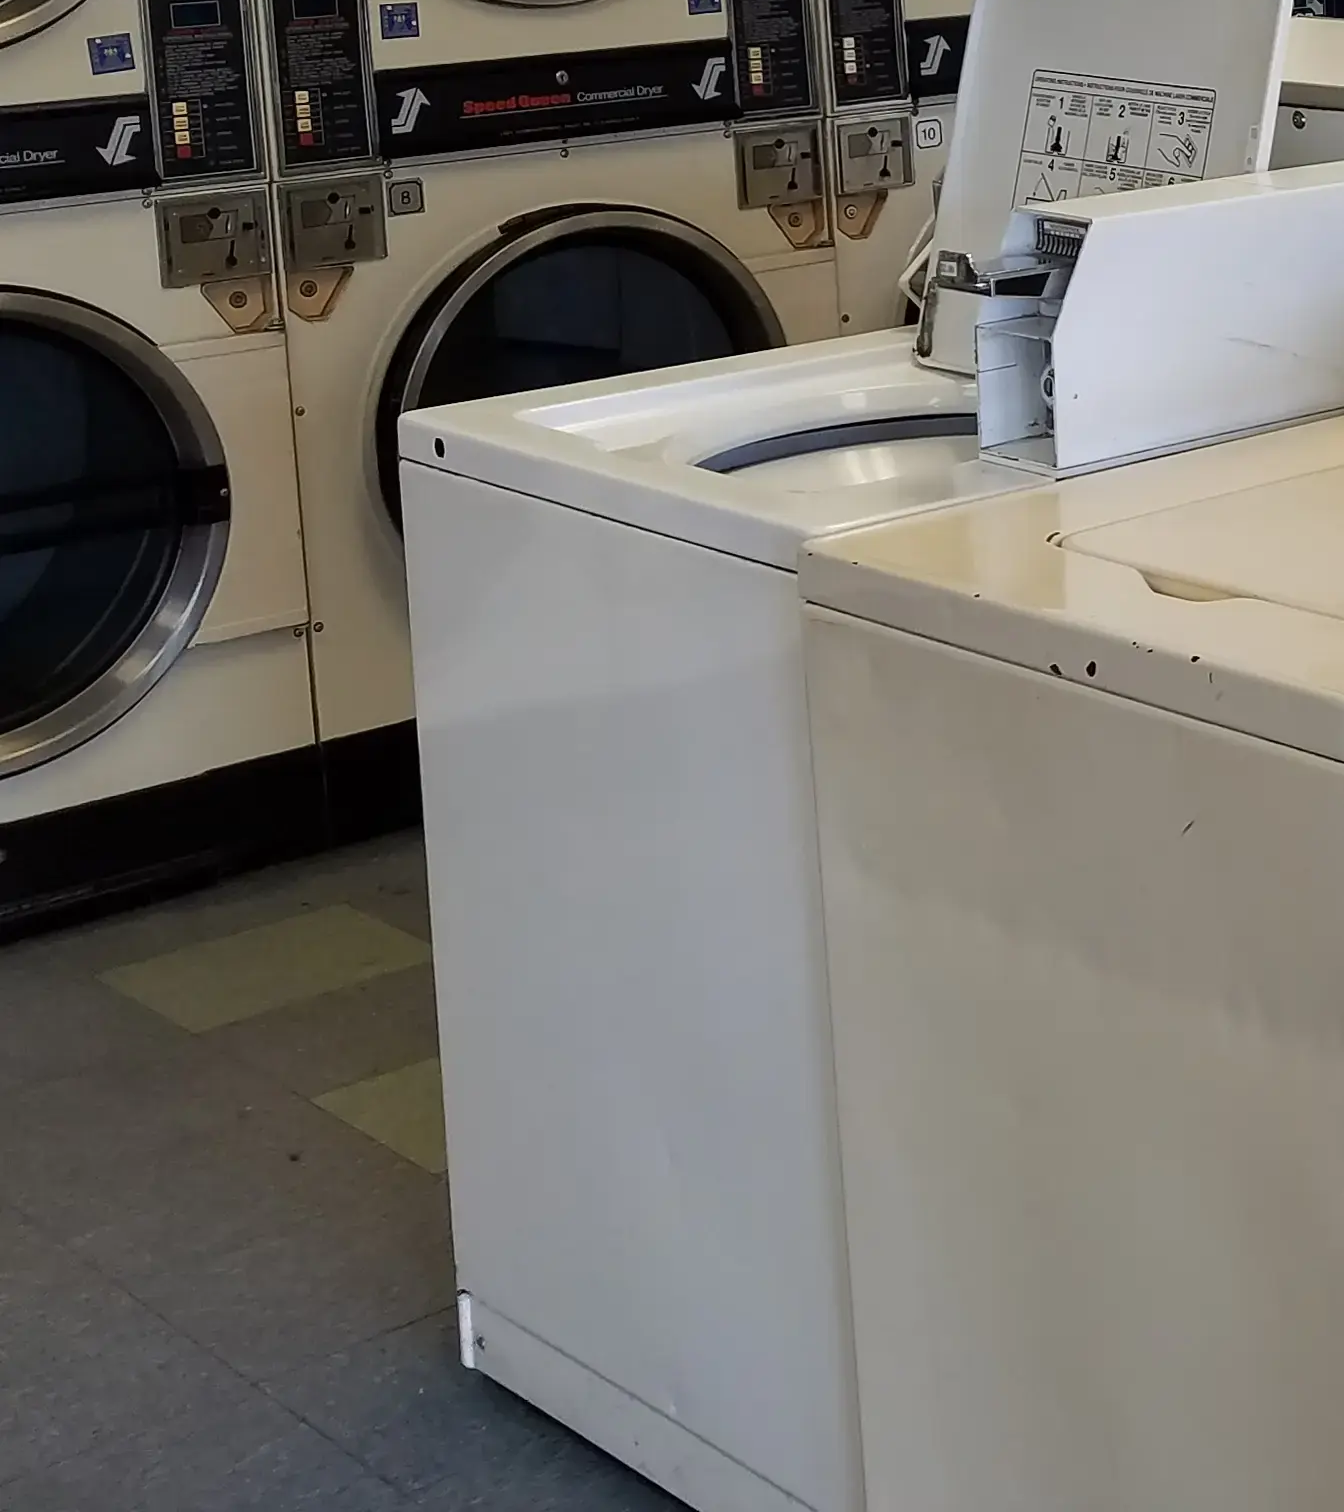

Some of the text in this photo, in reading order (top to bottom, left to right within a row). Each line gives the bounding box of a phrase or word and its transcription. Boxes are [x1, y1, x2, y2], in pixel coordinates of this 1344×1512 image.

[577, 87, 635, 102] Commercial
[637, 85, 664, 97] Dryer
[922, 127, 936, 142] 10
[23, 150, 58, 162] Dryer
